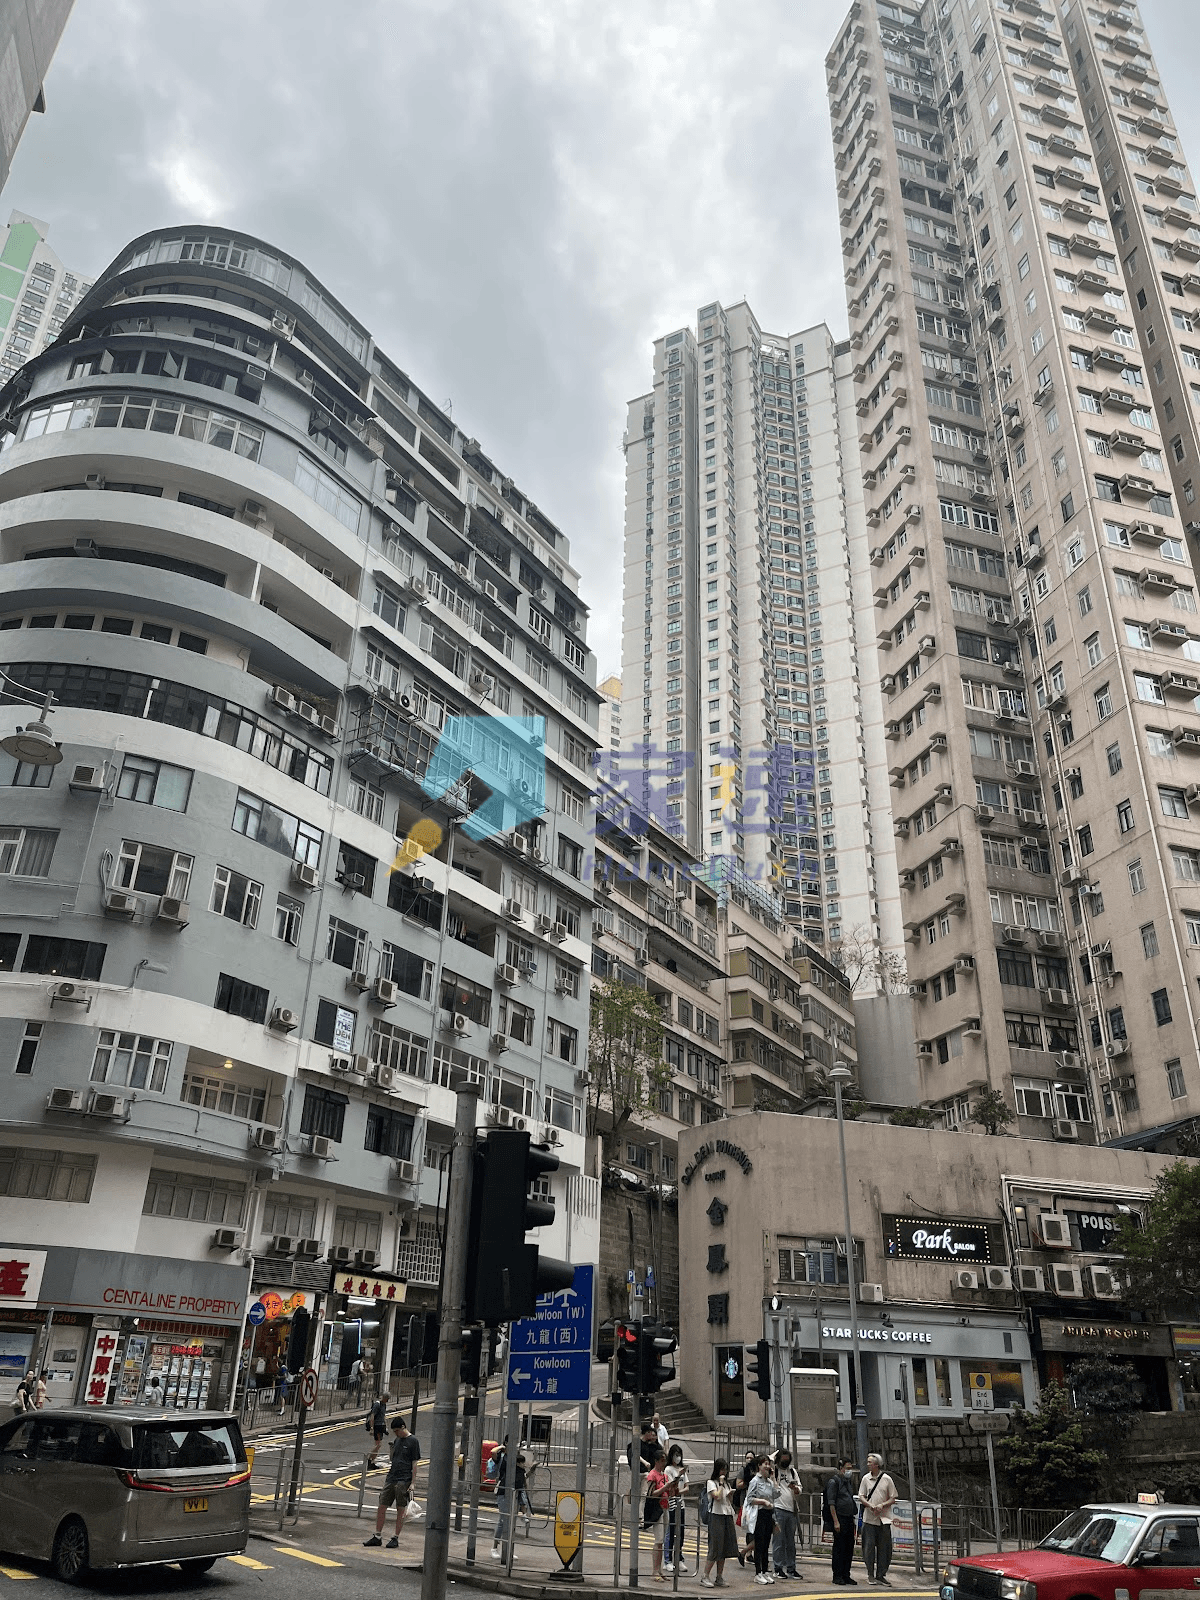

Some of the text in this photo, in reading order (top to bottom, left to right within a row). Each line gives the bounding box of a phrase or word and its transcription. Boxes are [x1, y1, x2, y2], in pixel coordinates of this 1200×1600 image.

[681, 1140, 715, 1186] GOLDEN
[912, 1228, 976, 1255] Park SALON
[103, 1288, 176, 1309] CENTALINE
[179, 1295, 241, 1315] PROPERTY
[527, 1308, 562, 1321] owloon
[822, 1326, 932, 1343] STARUCKS COFFEE
[88, 1334, 117, 1405] 中原地
[533, 1356, 571, 1369] Kowloon
[532, 1377, 558, 1394] 九龍
